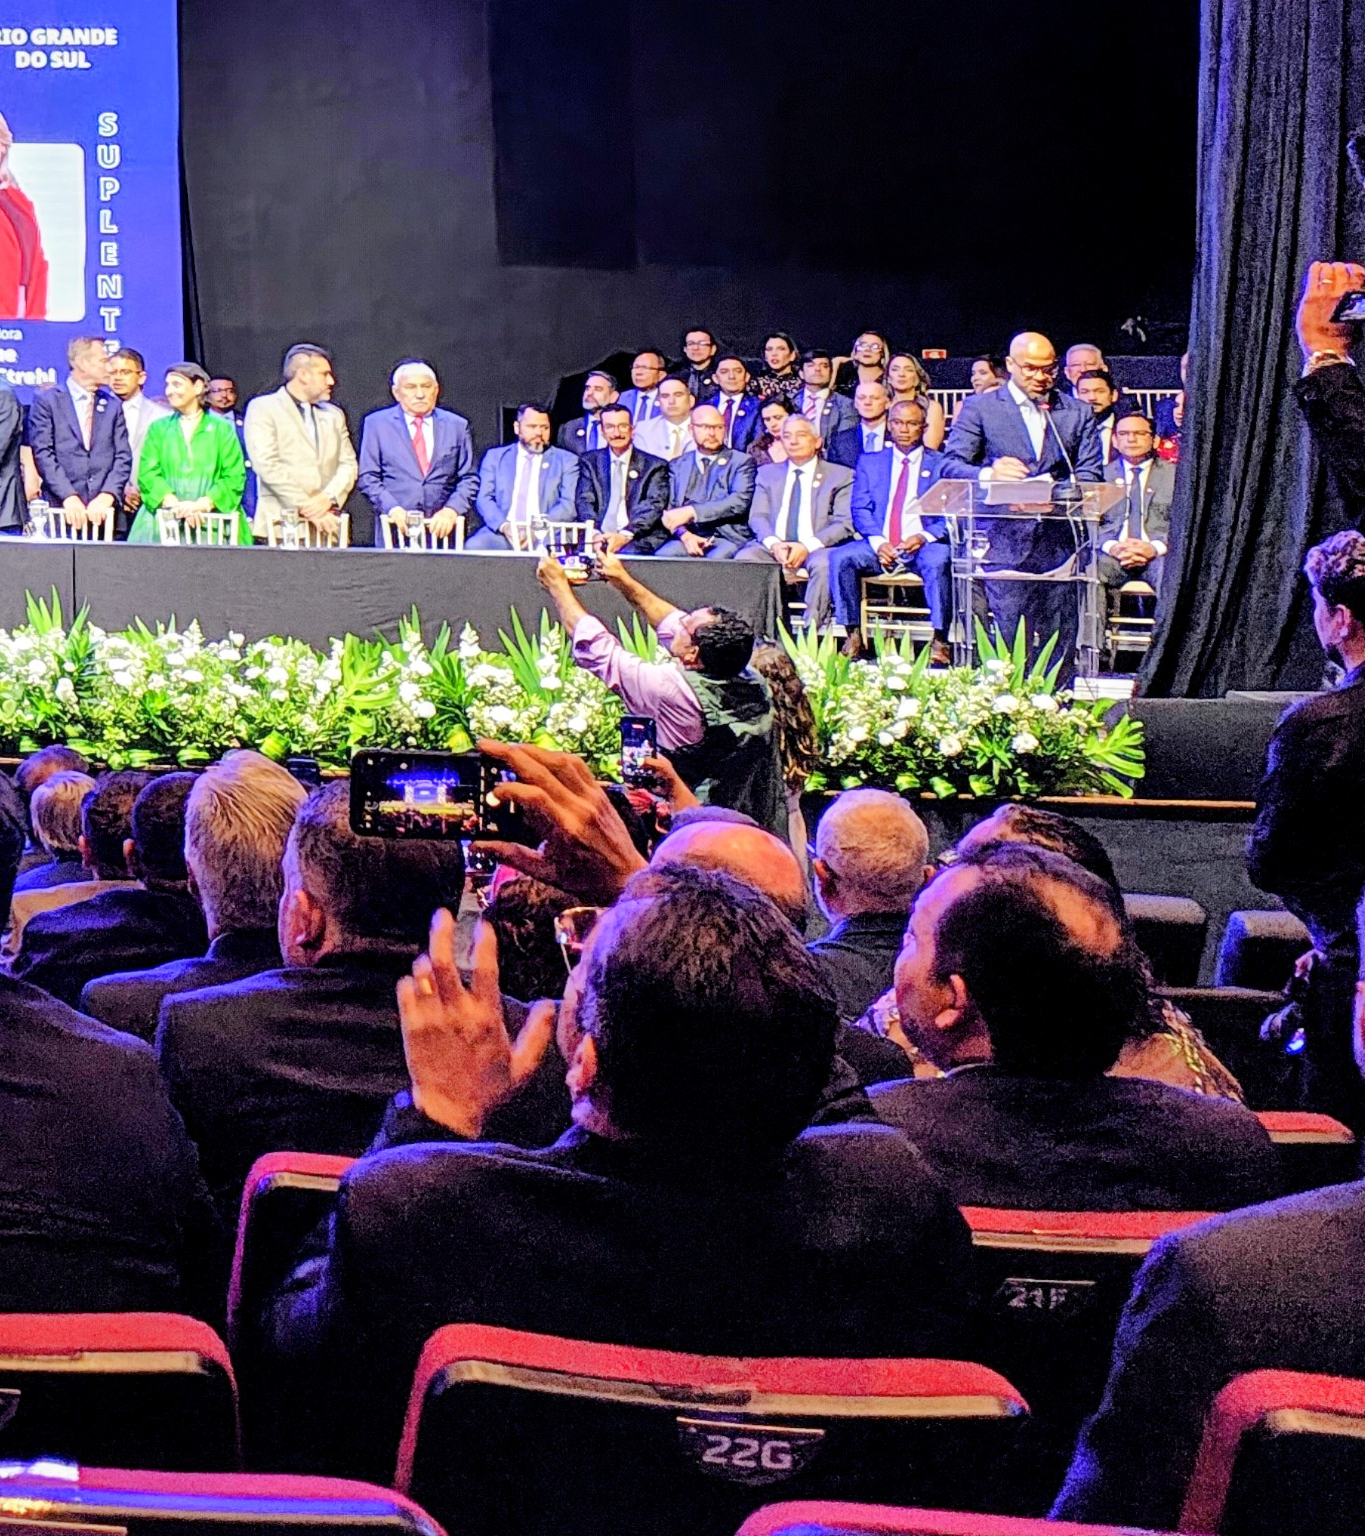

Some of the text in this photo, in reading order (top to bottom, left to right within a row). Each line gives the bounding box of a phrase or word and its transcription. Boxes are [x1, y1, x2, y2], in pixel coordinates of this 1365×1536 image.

[30, 27, 119, 46] GRANDE
[15, 50, 92, 70] DO SUL
[701, 1433, 794, 1470] 22G
